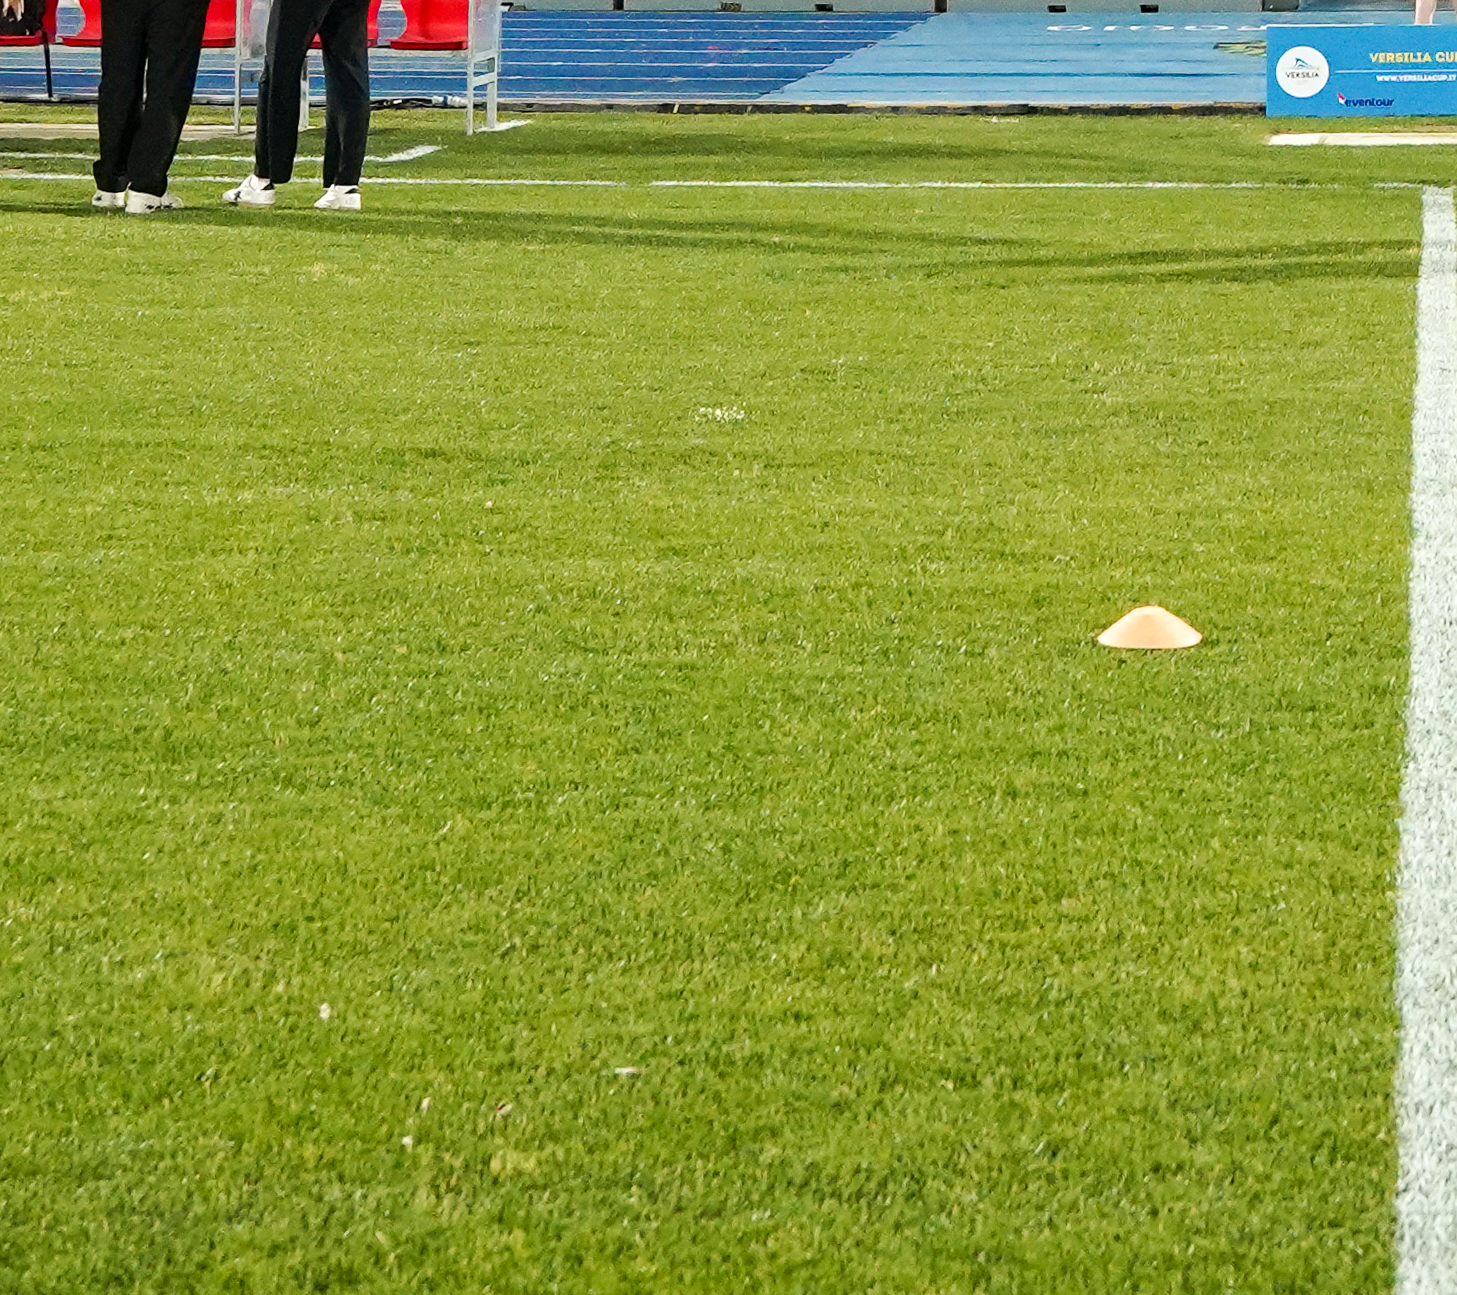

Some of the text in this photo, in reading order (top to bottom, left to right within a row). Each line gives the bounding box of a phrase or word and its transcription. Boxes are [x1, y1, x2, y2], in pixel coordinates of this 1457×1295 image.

[1369, 52, 1432, 63] VERSILIA
[1285, 70, 1320, 79] VERSILIA
[1345, 98, 1394, 107] eventour
